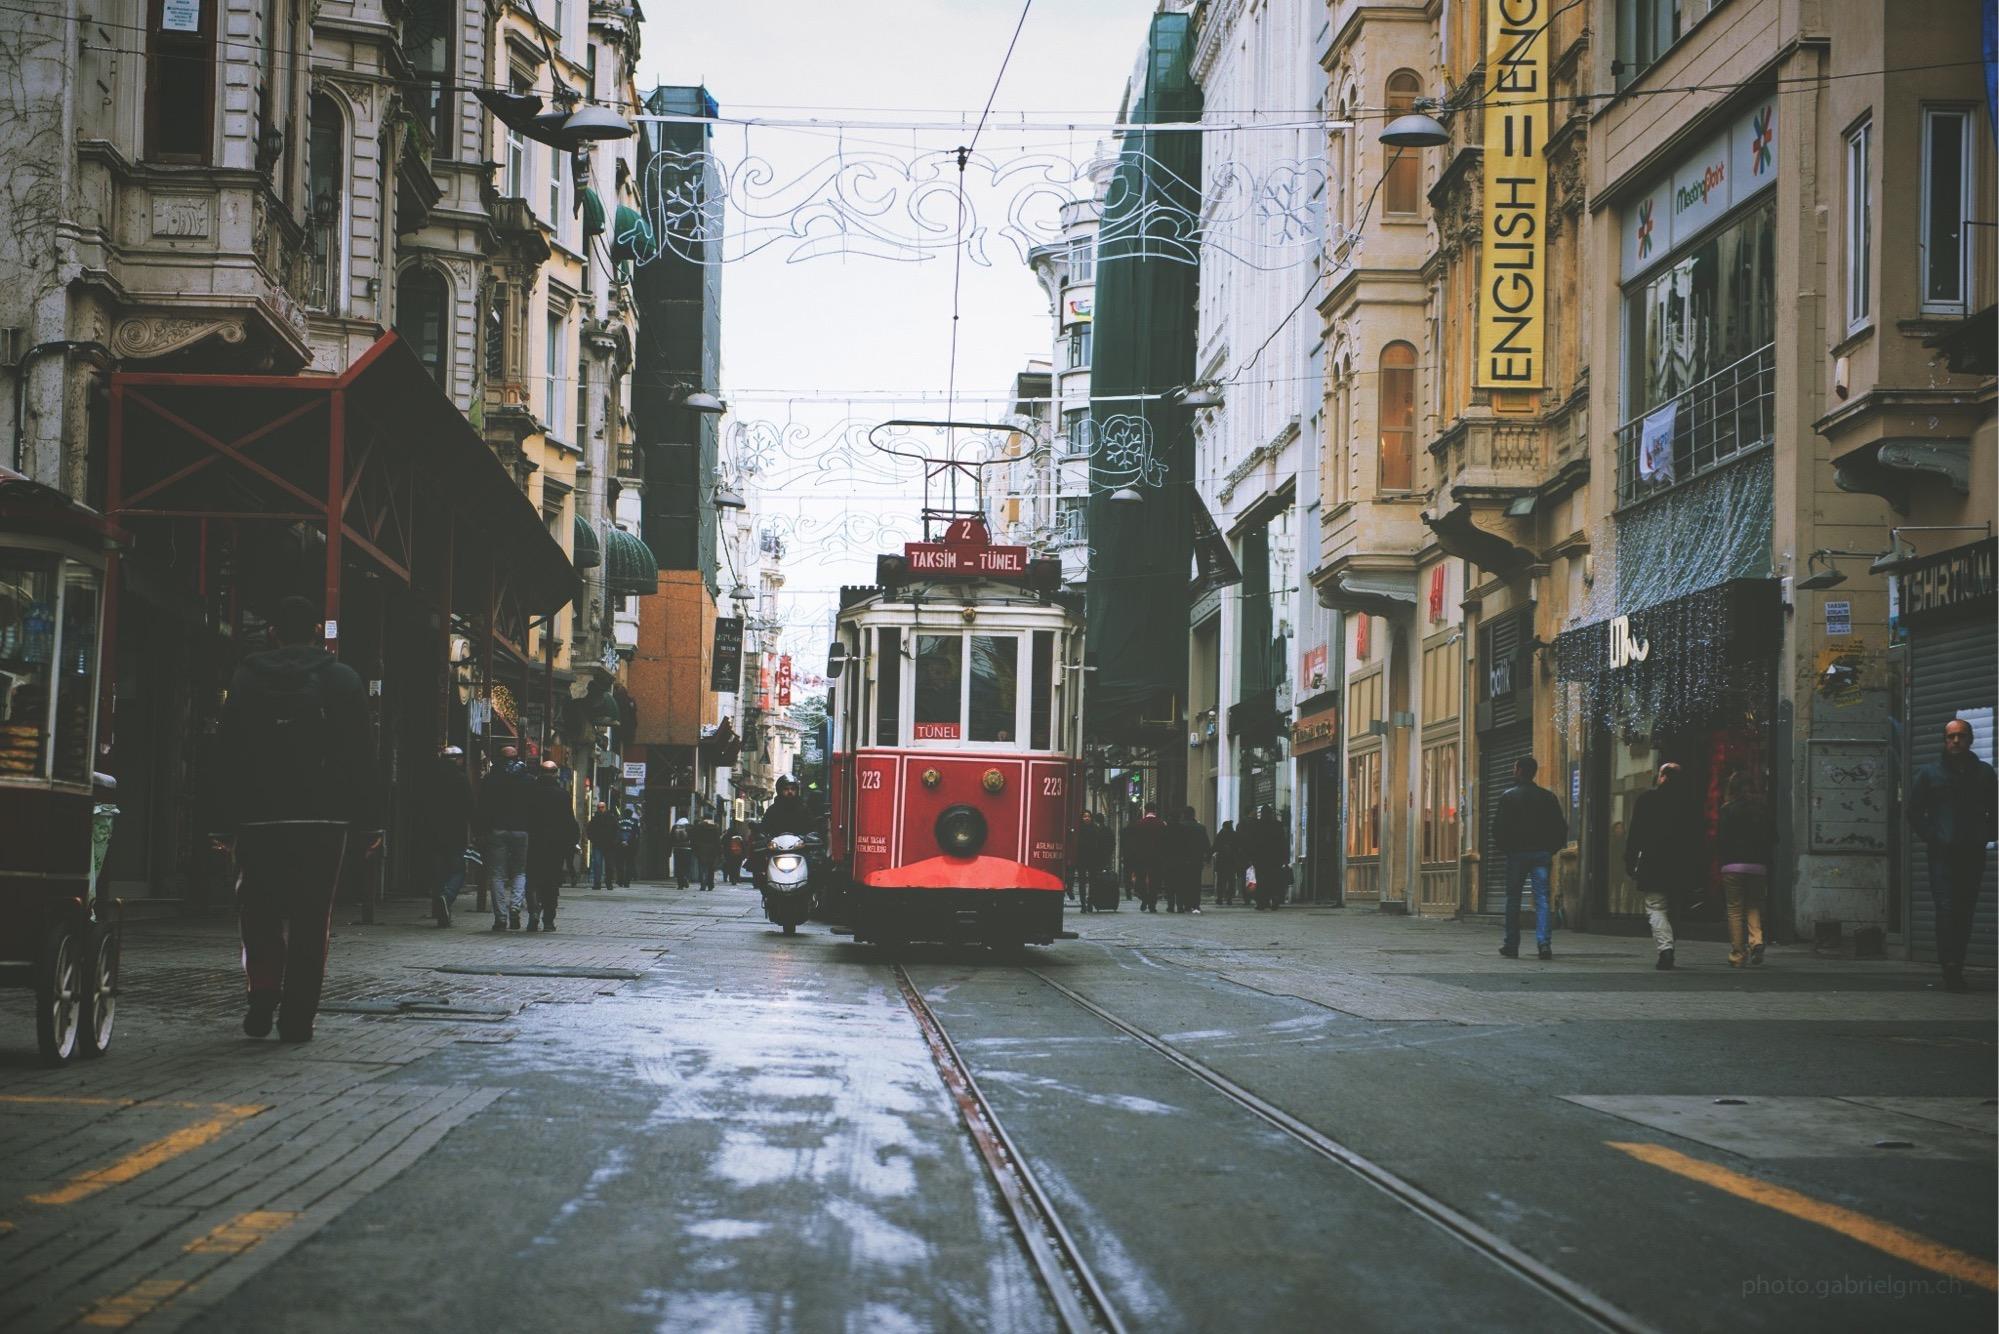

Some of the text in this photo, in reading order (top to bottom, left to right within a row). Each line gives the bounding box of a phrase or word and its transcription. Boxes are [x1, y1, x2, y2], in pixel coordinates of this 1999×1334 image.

[1491, 177, 1537, 381] ENGLISH
[961, 521, 971, 540] 2
[980, 550, 1022, 571] TÜNEL
[917, 724, 958, 738] TÜNEL
[862, 771, 880, 789] 223
[1043, 777, 1062, 796] 223
